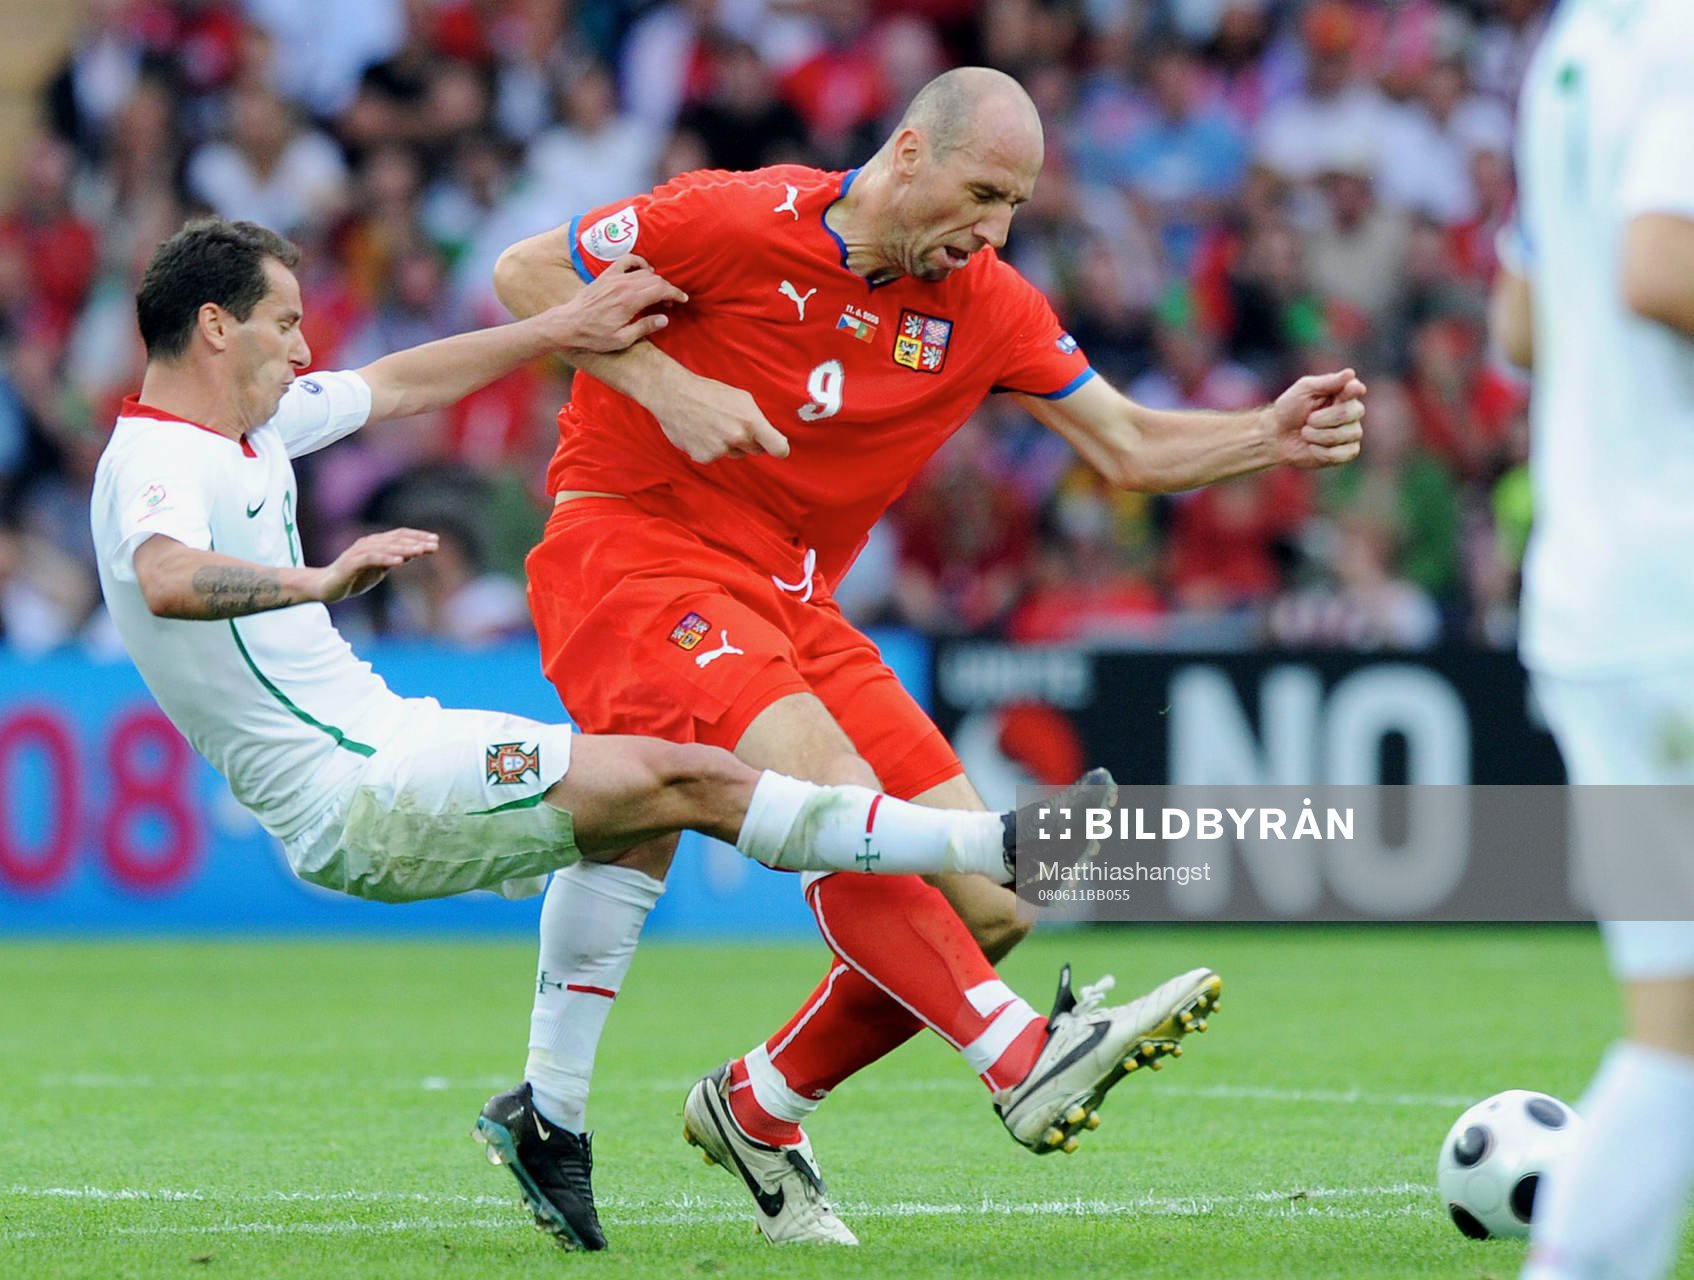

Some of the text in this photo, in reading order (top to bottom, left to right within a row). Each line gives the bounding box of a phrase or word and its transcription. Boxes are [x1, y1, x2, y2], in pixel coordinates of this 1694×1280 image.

[797, 359, 844, 422] 9
[0, 707, 202, 889] 08
[1168, 664, 1471, 915] NO
